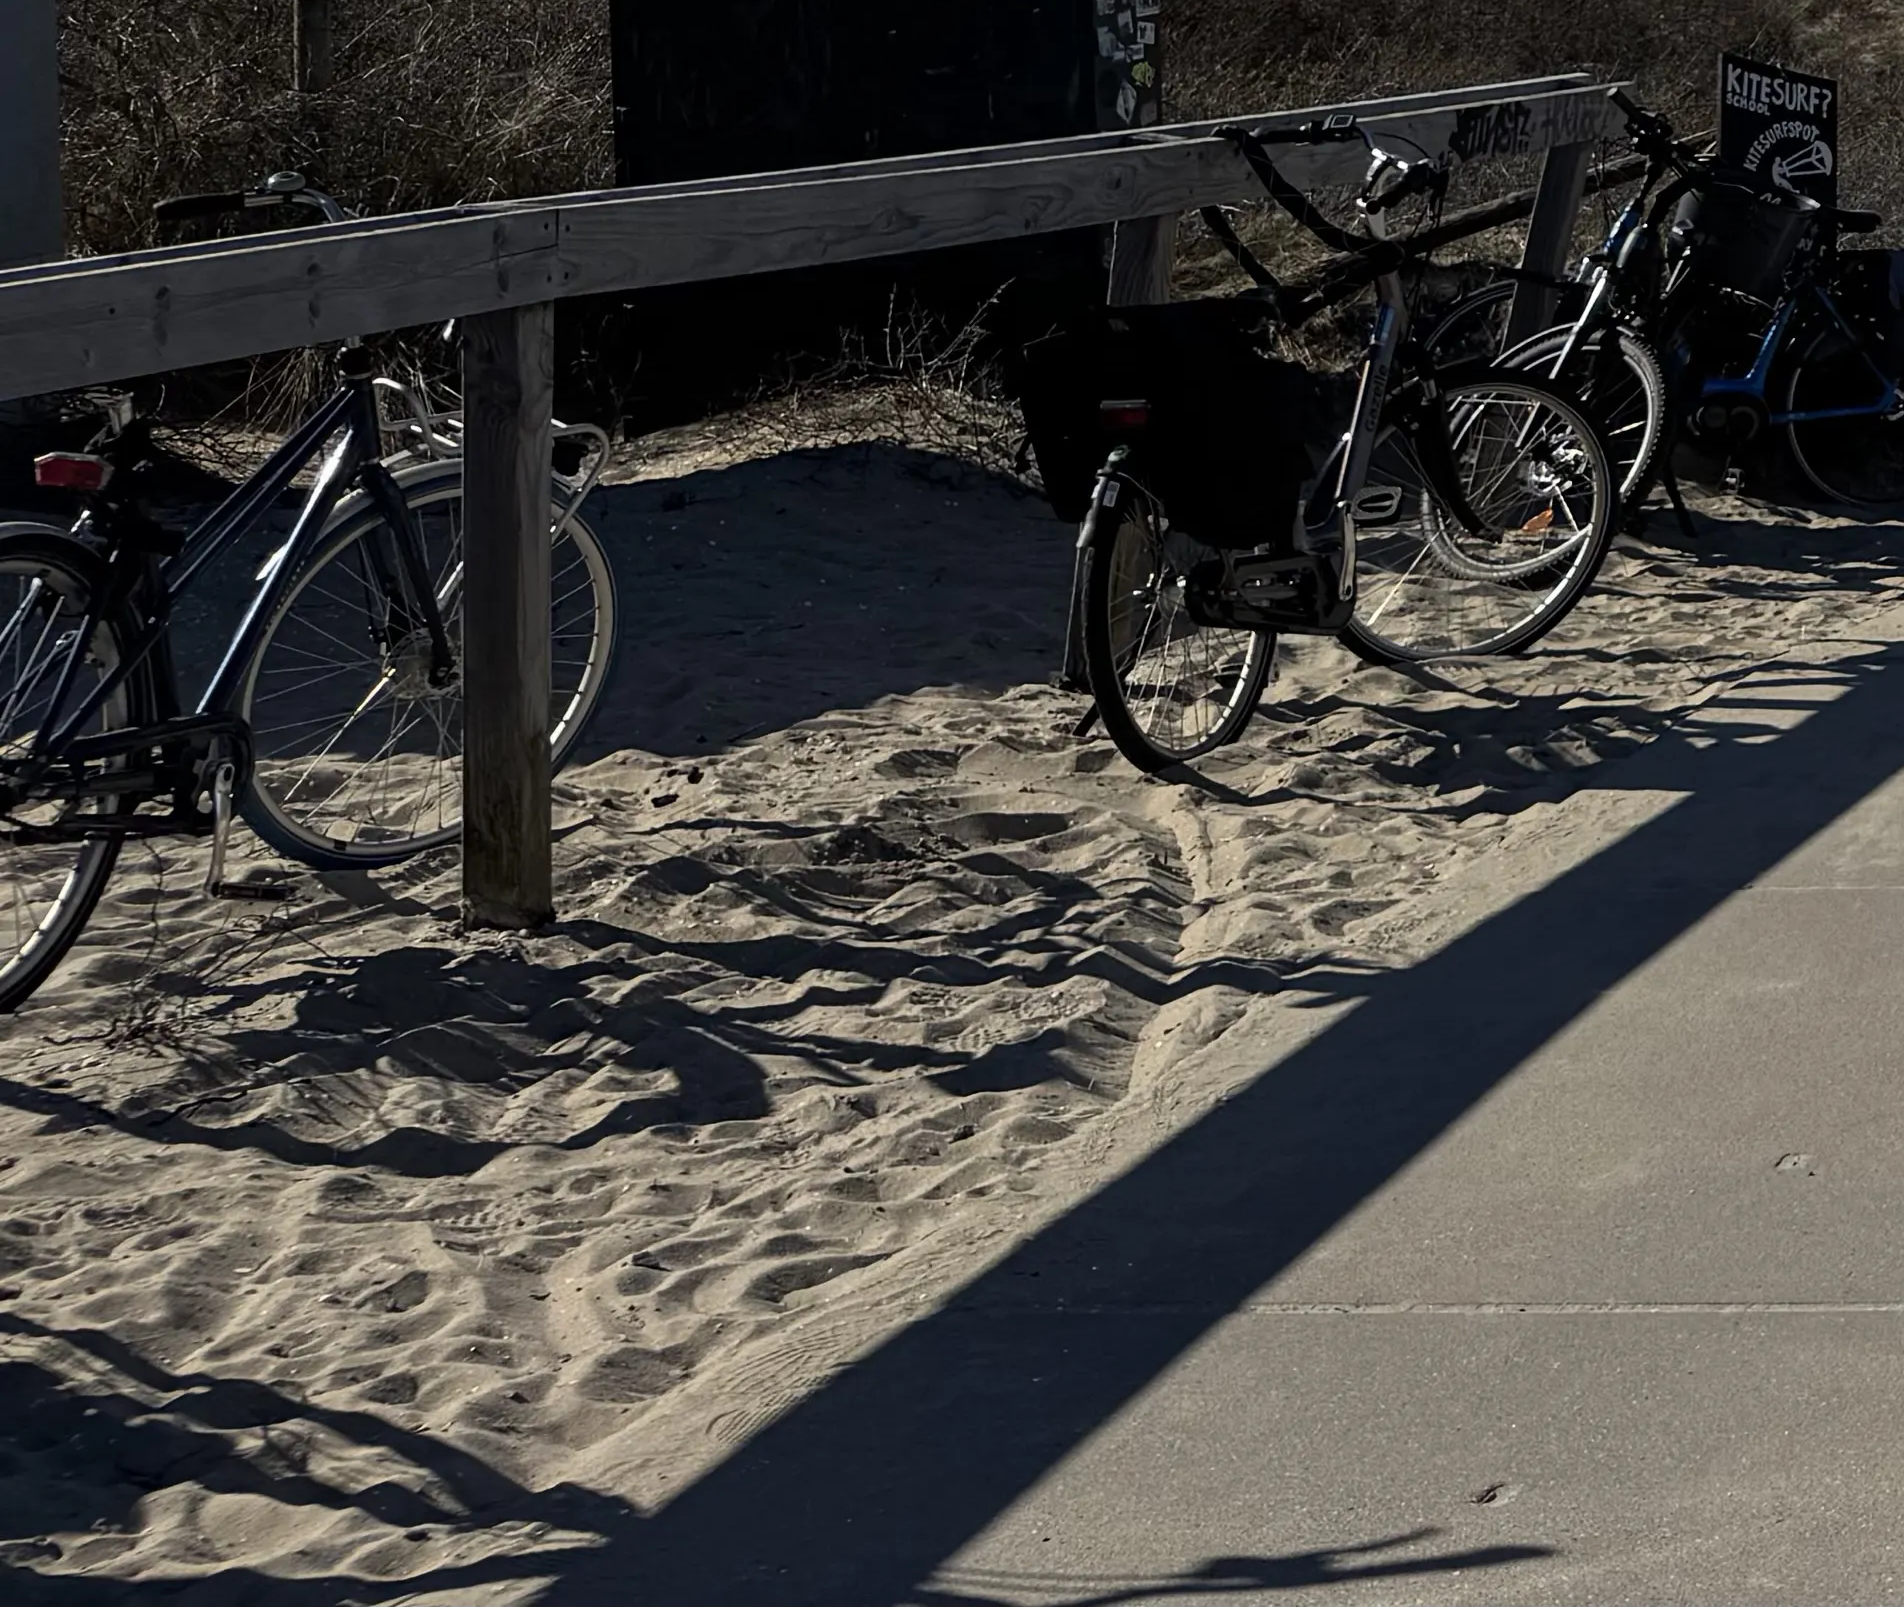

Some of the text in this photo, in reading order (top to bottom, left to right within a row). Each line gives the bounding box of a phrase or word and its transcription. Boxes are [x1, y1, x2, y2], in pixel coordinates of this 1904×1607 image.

[1726, 92, 1771, 116] SCHOOL
[1727, 63, 1833, 119] KITESURF?
[1743, 120, 1821, 172] KITESURFSPOT
